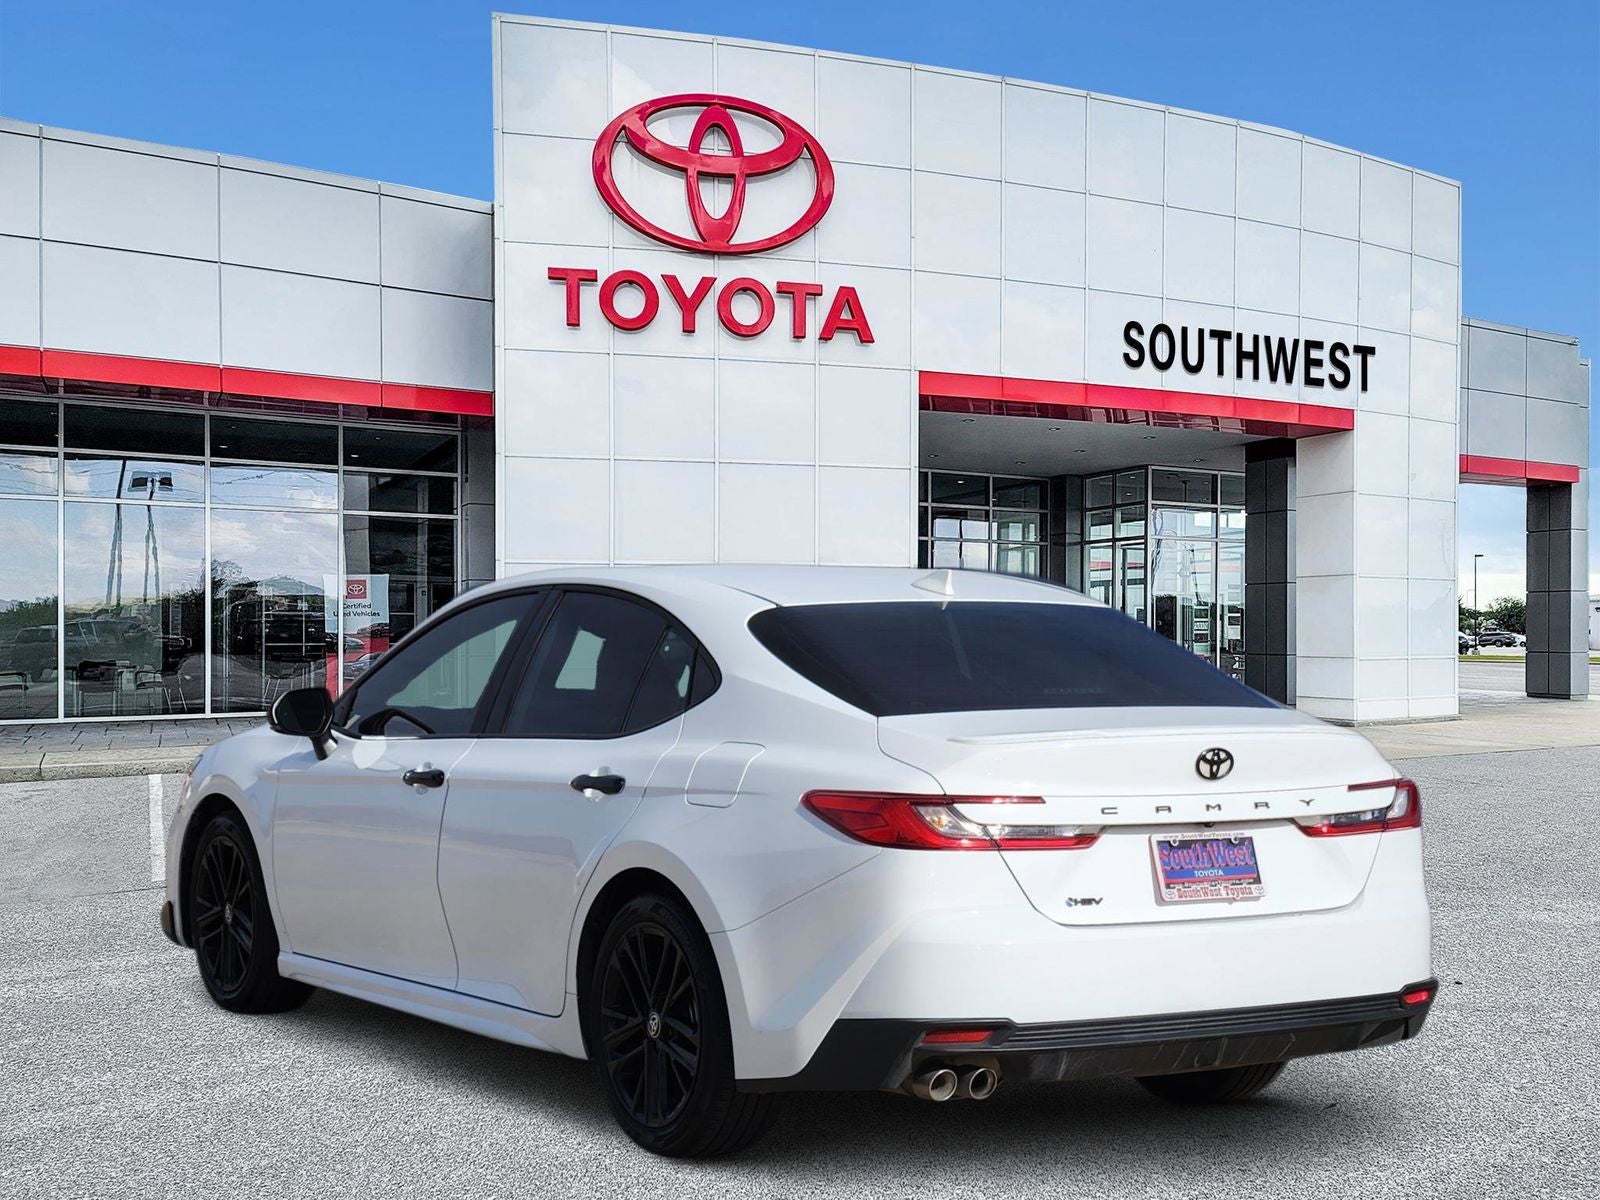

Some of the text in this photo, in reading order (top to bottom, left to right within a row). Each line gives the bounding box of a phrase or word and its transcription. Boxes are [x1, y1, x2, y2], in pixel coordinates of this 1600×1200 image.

[547, 267, 875, 344] TOYOTA
[1122, 320, 1376, 393] SOUTHWEST
[1101, 799, 1315, 815] CAMRY
[1158, 840, 1255, 871] SouthWest
[1194, 869, 1224, 878] TOYOTA
[1176, 885, 1254, 899] SouthWest Toyota
